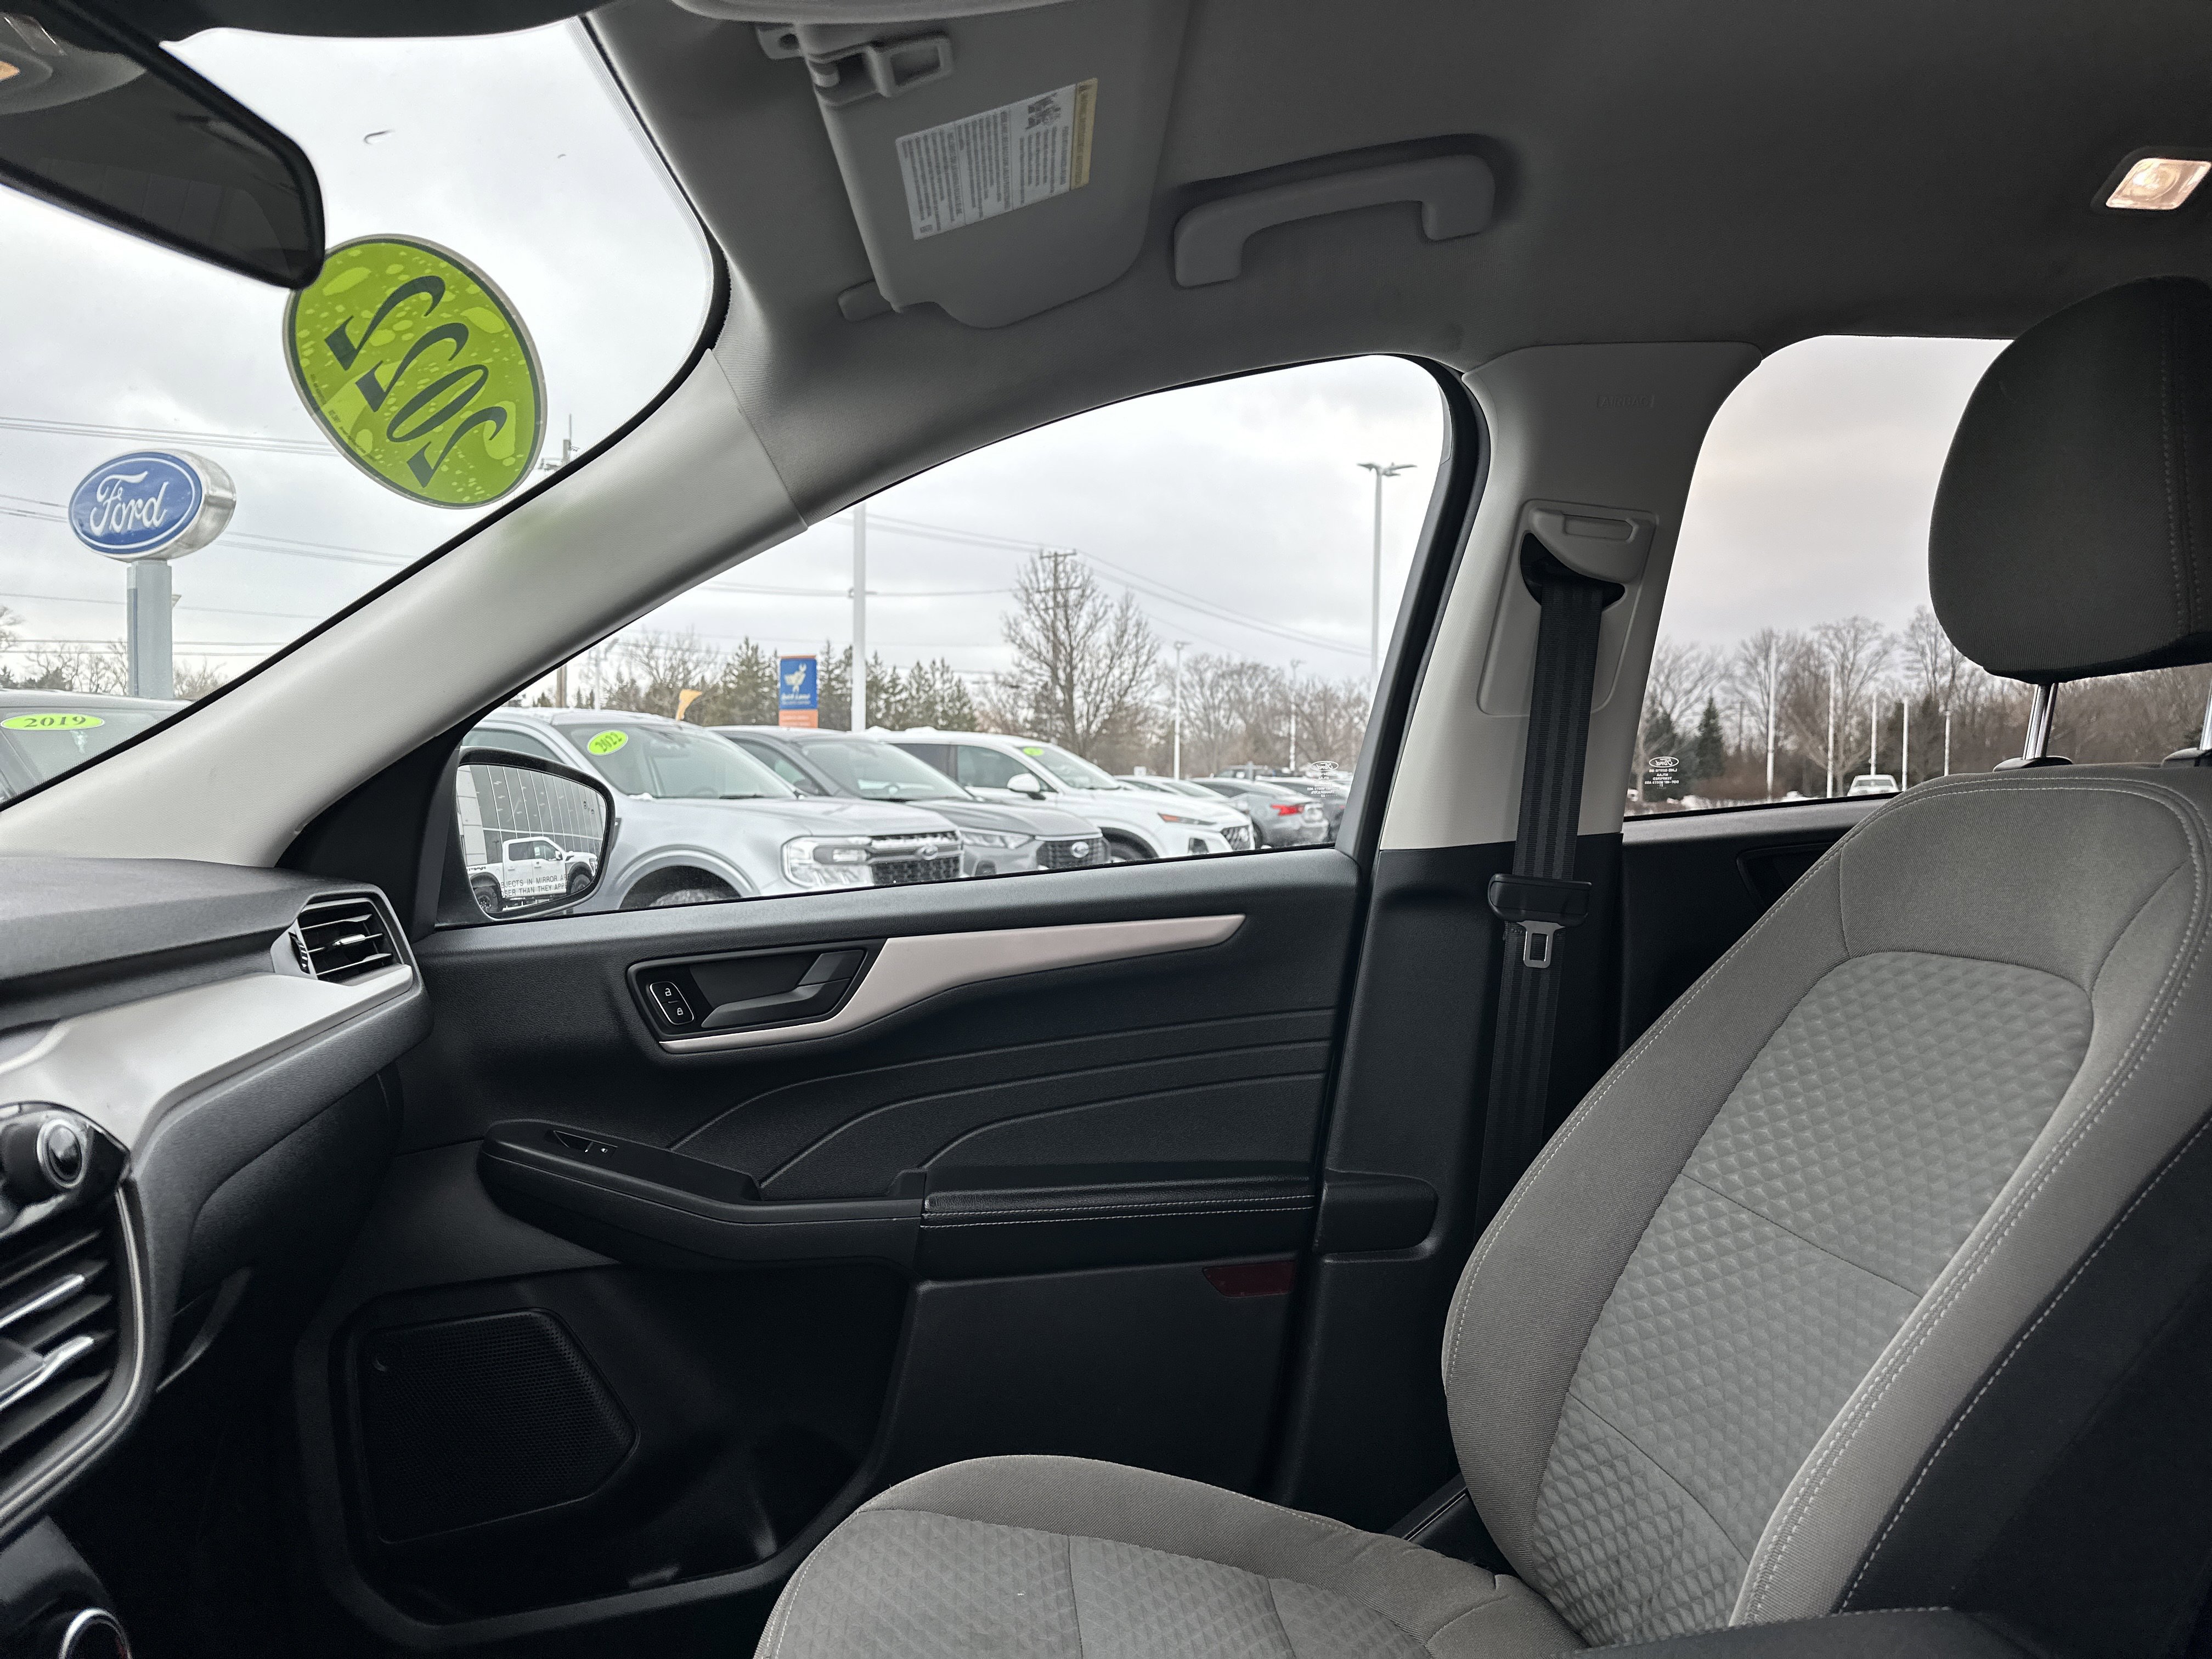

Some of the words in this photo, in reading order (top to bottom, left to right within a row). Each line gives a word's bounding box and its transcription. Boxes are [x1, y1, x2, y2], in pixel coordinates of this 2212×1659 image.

[89, 470, 169, 537] Ford
[24, 715, 86, 728] 2019
[500, 879, 524, 888] BJECTS
[536, 875, 557, 884] MIRROR
[519, 886, 535, 895] THAN
[538, 884, 552, 893] THEY
